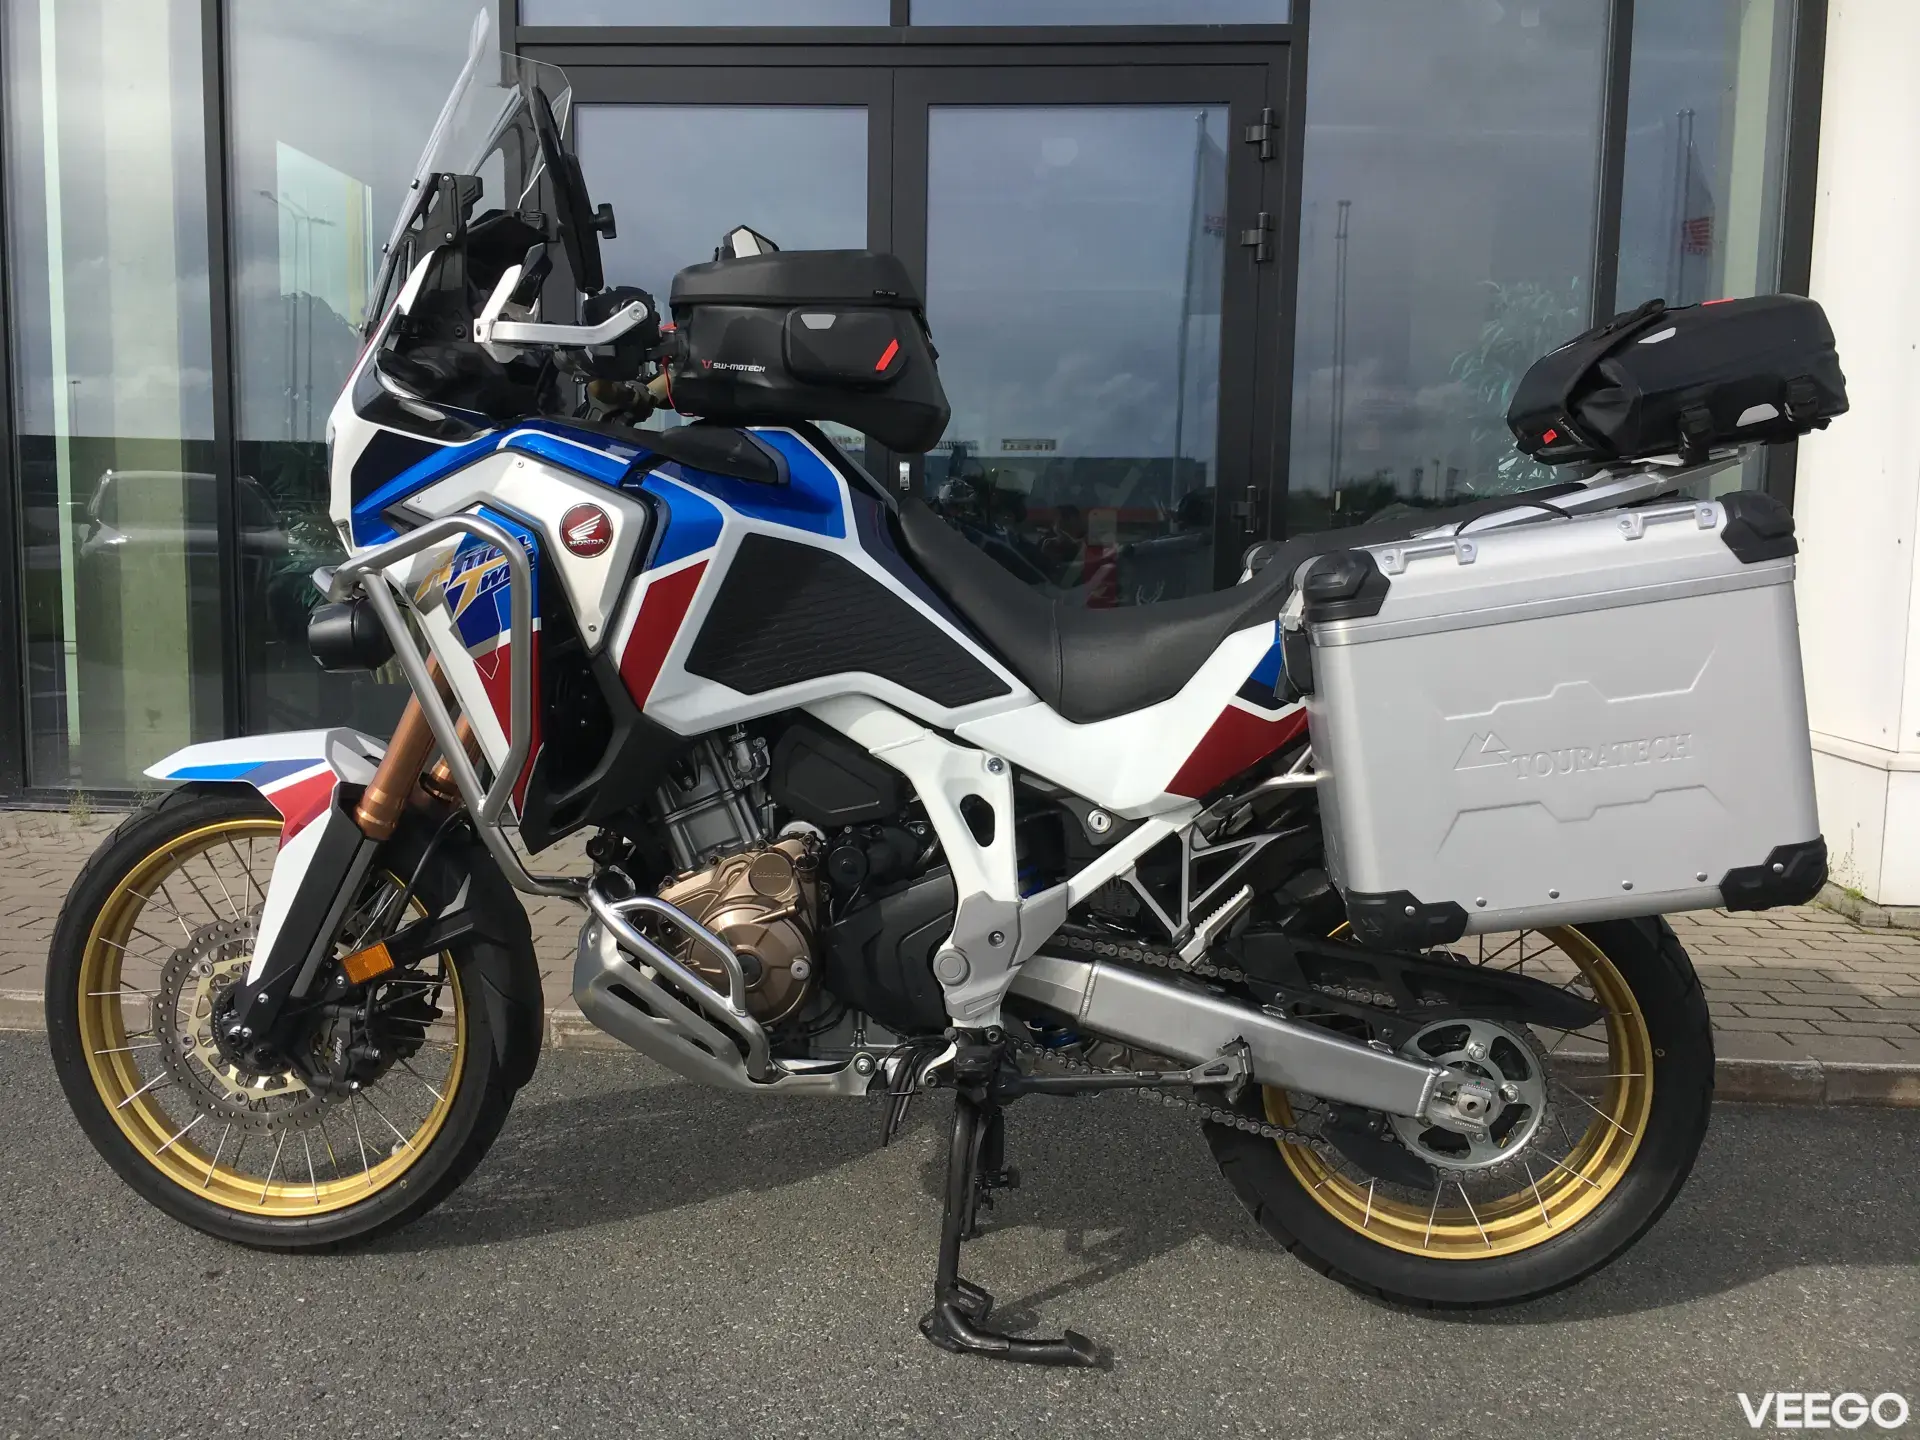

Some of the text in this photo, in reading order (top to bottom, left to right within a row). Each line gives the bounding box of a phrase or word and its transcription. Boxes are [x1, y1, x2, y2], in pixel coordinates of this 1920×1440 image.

[713, 362, 766, 373] SW-MOTECH
[568, 539, 606, 547] HONDA
[1512, 733, 1695, 779] TOURATECH
